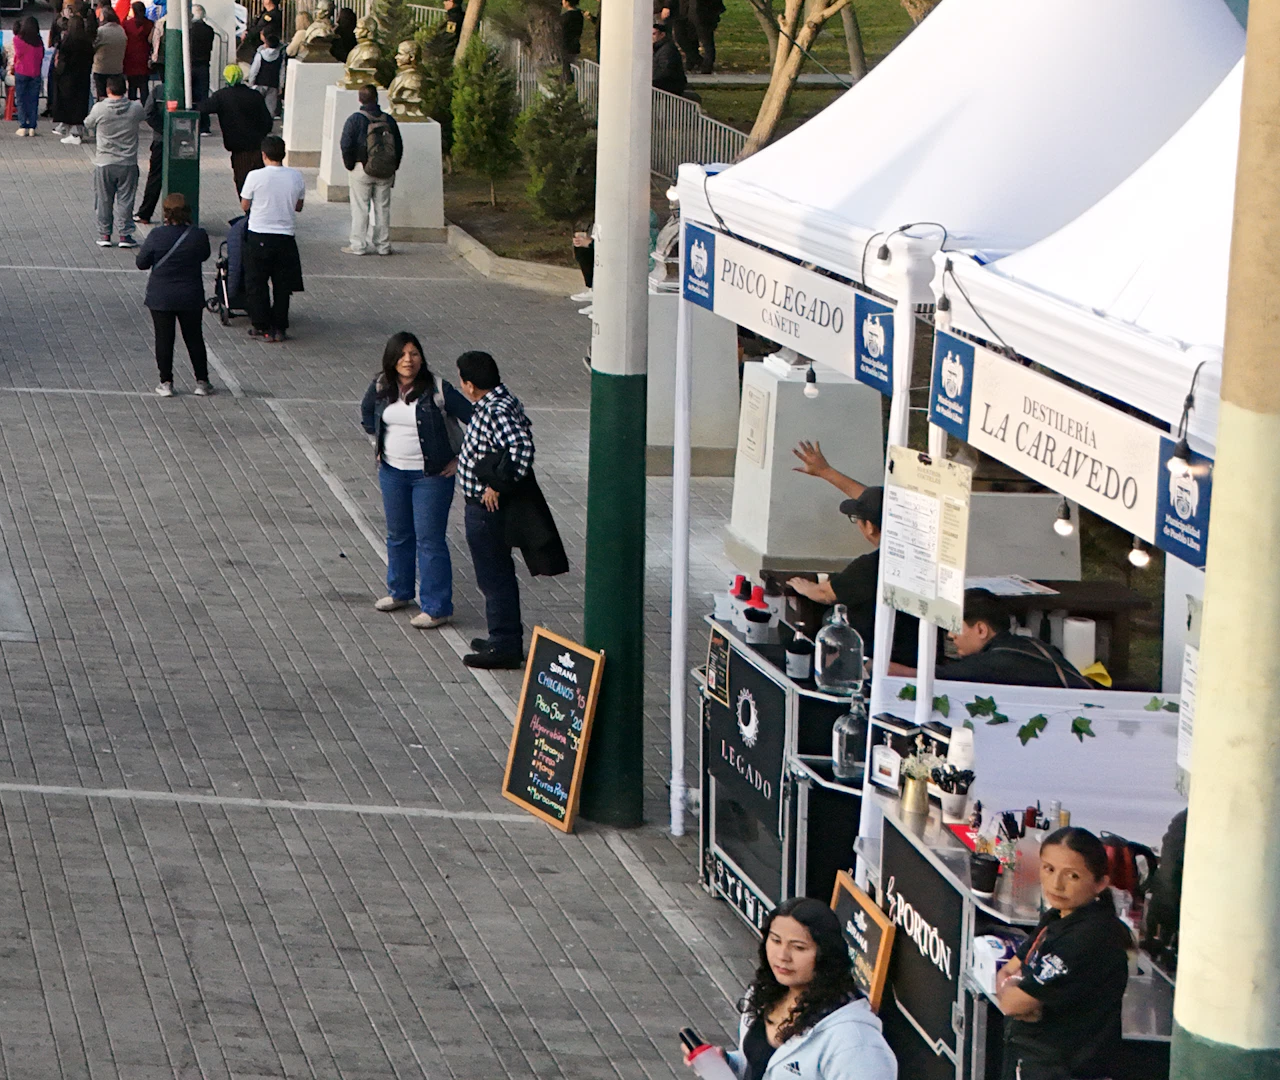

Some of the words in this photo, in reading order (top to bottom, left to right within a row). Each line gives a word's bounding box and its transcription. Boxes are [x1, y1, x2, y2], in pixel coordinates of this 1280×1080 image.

[720, 258, 766, 299] PISCO
[771, 280, 844, 334] LEGADO
[761, 308, 800, 339] CAÑETE
[1023, 395, 1097, 450] DESTILERÍA
[980, 402, 1010, 443] LA
[1015, 421, 1138, 510] CARAVEDO
[1165, 514, 1200, 539] Municipalidad
[550, 662, 577, 684] SIRANA
[530, 714, 566, 744] Algarrobina
[535, 694, 550, 713] Pisco
[550, 702, 566, 721] Sour
[572, 716, 582, 730] 20
[720, 739, 772, 800] LEGADO
[846, 920, 868, 953] SIRANA
[896, 892, 952, 980] PORTÓN
